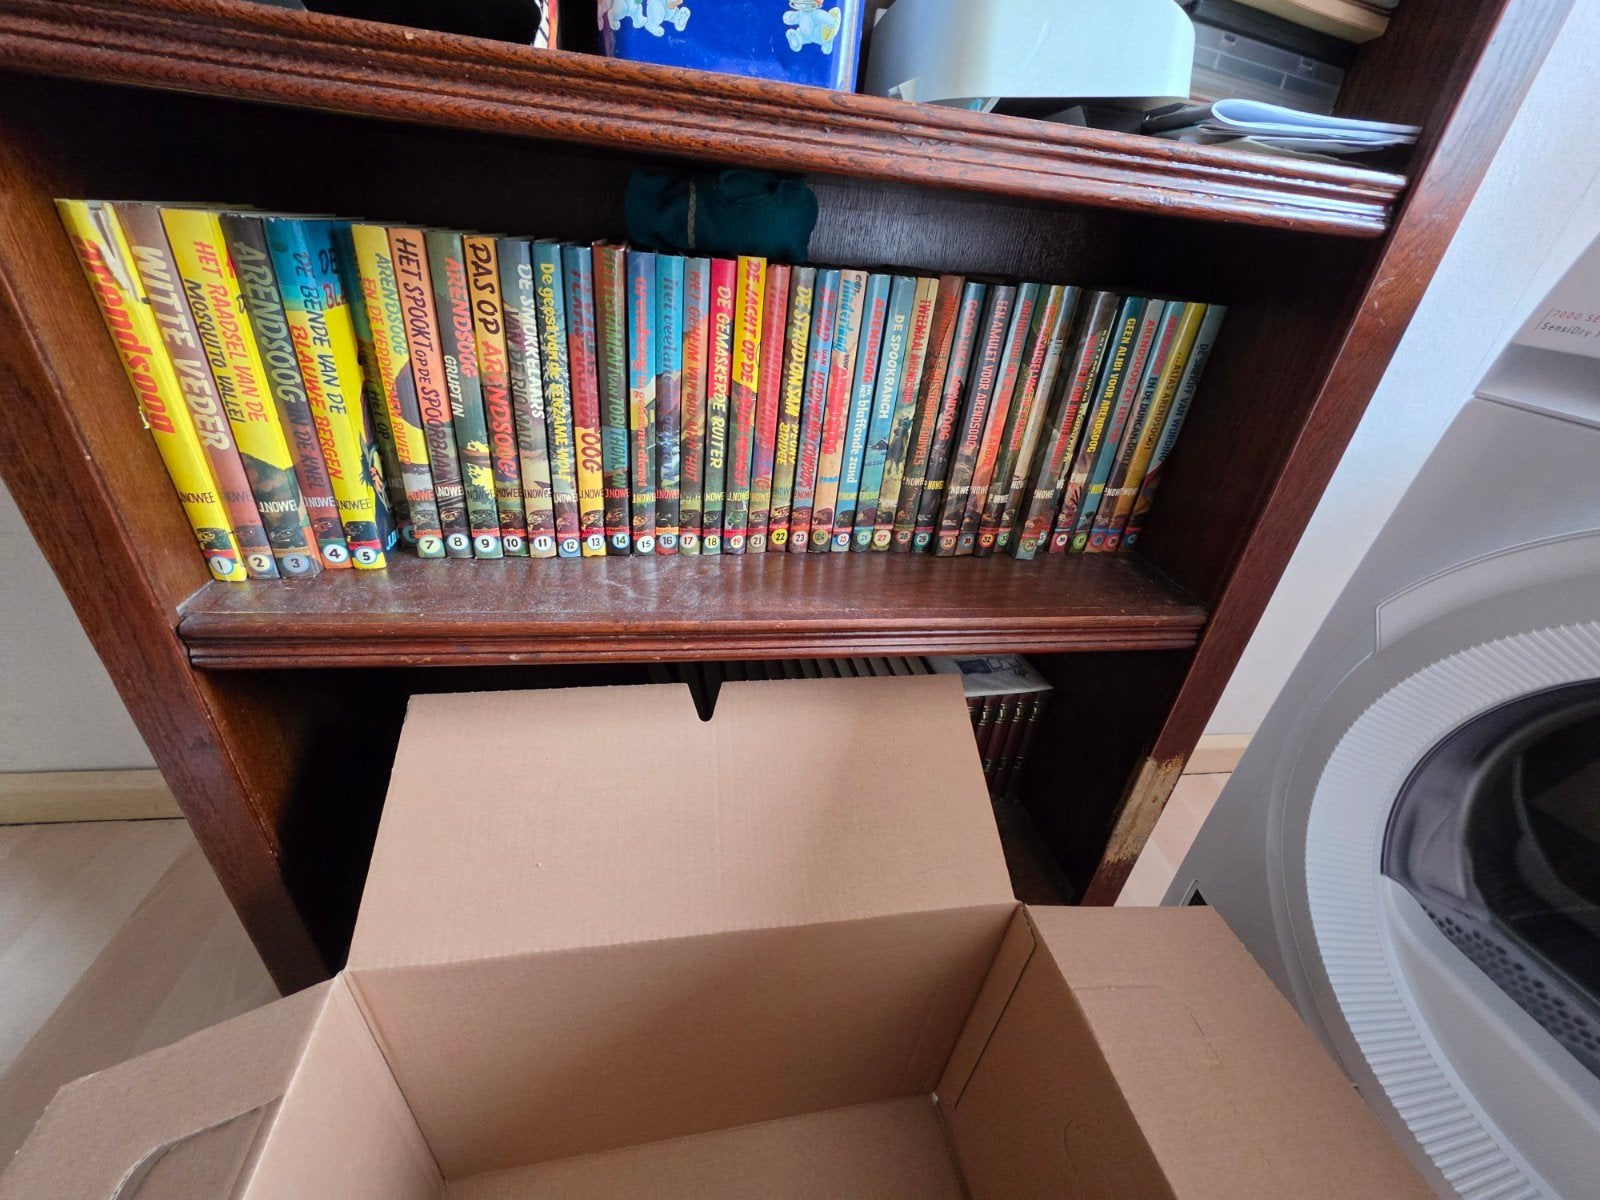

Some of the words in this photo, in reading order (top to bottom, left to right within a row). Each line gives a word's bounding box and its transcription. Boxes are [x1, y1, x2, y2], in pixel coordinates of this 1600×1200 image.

[193, 241, 223, 275] HET
[291, 251, 313, 279] DE
[393, 237, 422, 280] HET
[469, 242, 496, 295] PAS
[517, 263, 534, 291] DE
[746, 260, 761, 286] DE
[363, 277, 380, 302] EN
[717, 286, 731, 308] DE
[795, 285, 812, 311] DE
[300, 285, 331, 347] BENDE
[368, 305, 385, 328] DE
[375, 253, 410, 357] ARENDSOOG
[402, 282, 434, 352] SPOOKT
[477, 299, 499, 335] OP
[744, 284, 760, 335] JACHT
[994, 300, 1008, 319] EEN
[207, 284, 248, 359] RAADSEL
[232, 241, 308, 404] ARENDSOOG
[444, 257, 479, 379] ARENDSOOG
[894, 315, 905, 332] DE
[912, 299, 931, 352] TWEEMAAL
[1541, 322, 1592, 338] SensiDry
[688, 306, 701, 365] GEHEIM
[863, 298, 884, 383] ARENDSOOG
[985, 321, 1004, 363] AMULET
[1121, 318, 1137, 344] GEEN
[130, 244, 197, 348] WITTE
[173, 359, 233, 451] VEDER
[183, 280, 228, 369] MOSQUITO
[216, 375, 245, 424] VALLEI
[414, 349, 429, 367] OP
[509, 348, 524, 371] DE
[520, 295, 544, 420] SMOKKELAARS
[743, 340, 756, 360] OP
[1113, 346, 1128, 371] ALIBI
[1128, 320, 1156, 385] ARENDSOOG
[1197, 344, 1209, 358] DE
[318, 355, 340, 389] VAN
[373, 329, 405, 419] VERDWENEN
[541, 262, 557, 288] De
[555, 448, 571, 483] WOLF
[713, 312, 731, 412] GEMASKERDE
[741, 363, 755, 383] DE
[233, 366, 260, 399] VAN
[417, 368, 432, 385] DE
[443, 355, 463, 402] GRIJPT
[688, 367, 700, 391] VAN
[880, 335, 902, 419] SPOOKRANCH
[978, 365, 994, 391] VOOR
[1104, 374, 1119, 399] VOOR
[1147, 377, 1158, 389] EN
[290, 325, 326, 411] BLAUWE
[315, 415, 344, 480] BERGEN
[327, 393, 347, 415] DE
[1143, 391, 1154, 402] DE
[1175, 398, 1189, 418] VAN
[245, 401, 268, 423] DE
[451, 402, 465, 418] IN
[481, 341, 517, 478] ARENDSOOG!
[377, 422, 391, 441] OP
[421, 387, 455, 484] SPOORBAAN
[851, 400, 869, 455] blaffende
[1087, 400, 1111, 453] ARENDSOOG
[293, 430, 315, 452] DE
[391, 422, 412, 466] RIVIER
[710, 416, 725, 469] RUITER
[302, 456, 325, 490] KNEL
[847, 457, 860, 483] zand
[425, 540, 434, 550] 7
[453, 537, 463, 547] 8
[481, 539, 490, 548] 9
[506, 539, 518, 548] 10
[538, 538, 547, 547] 11
[566, 541, 575, 549] 12
[591, 538, 600, 546] 13
[615, 536, 626, 545] 14
[641, 540, 651, 548] 15
[662, 536, 673, 545] 16
[683, 536, 693, 545] 17
[708, 538, 717, 546] 18
[776, 532, 785, 540] 22
[795, 534, 805, 542] 23
[899, 532, 909, 540] 28
[917, 535, 926, 543] 29
[217, 561, 224, 571] 1
[253, 558, 264, 568] 2
[290, 558, 300, 568] 3
[329, 548, 341, 559] 4
[362, 552, 371, 561] 5
